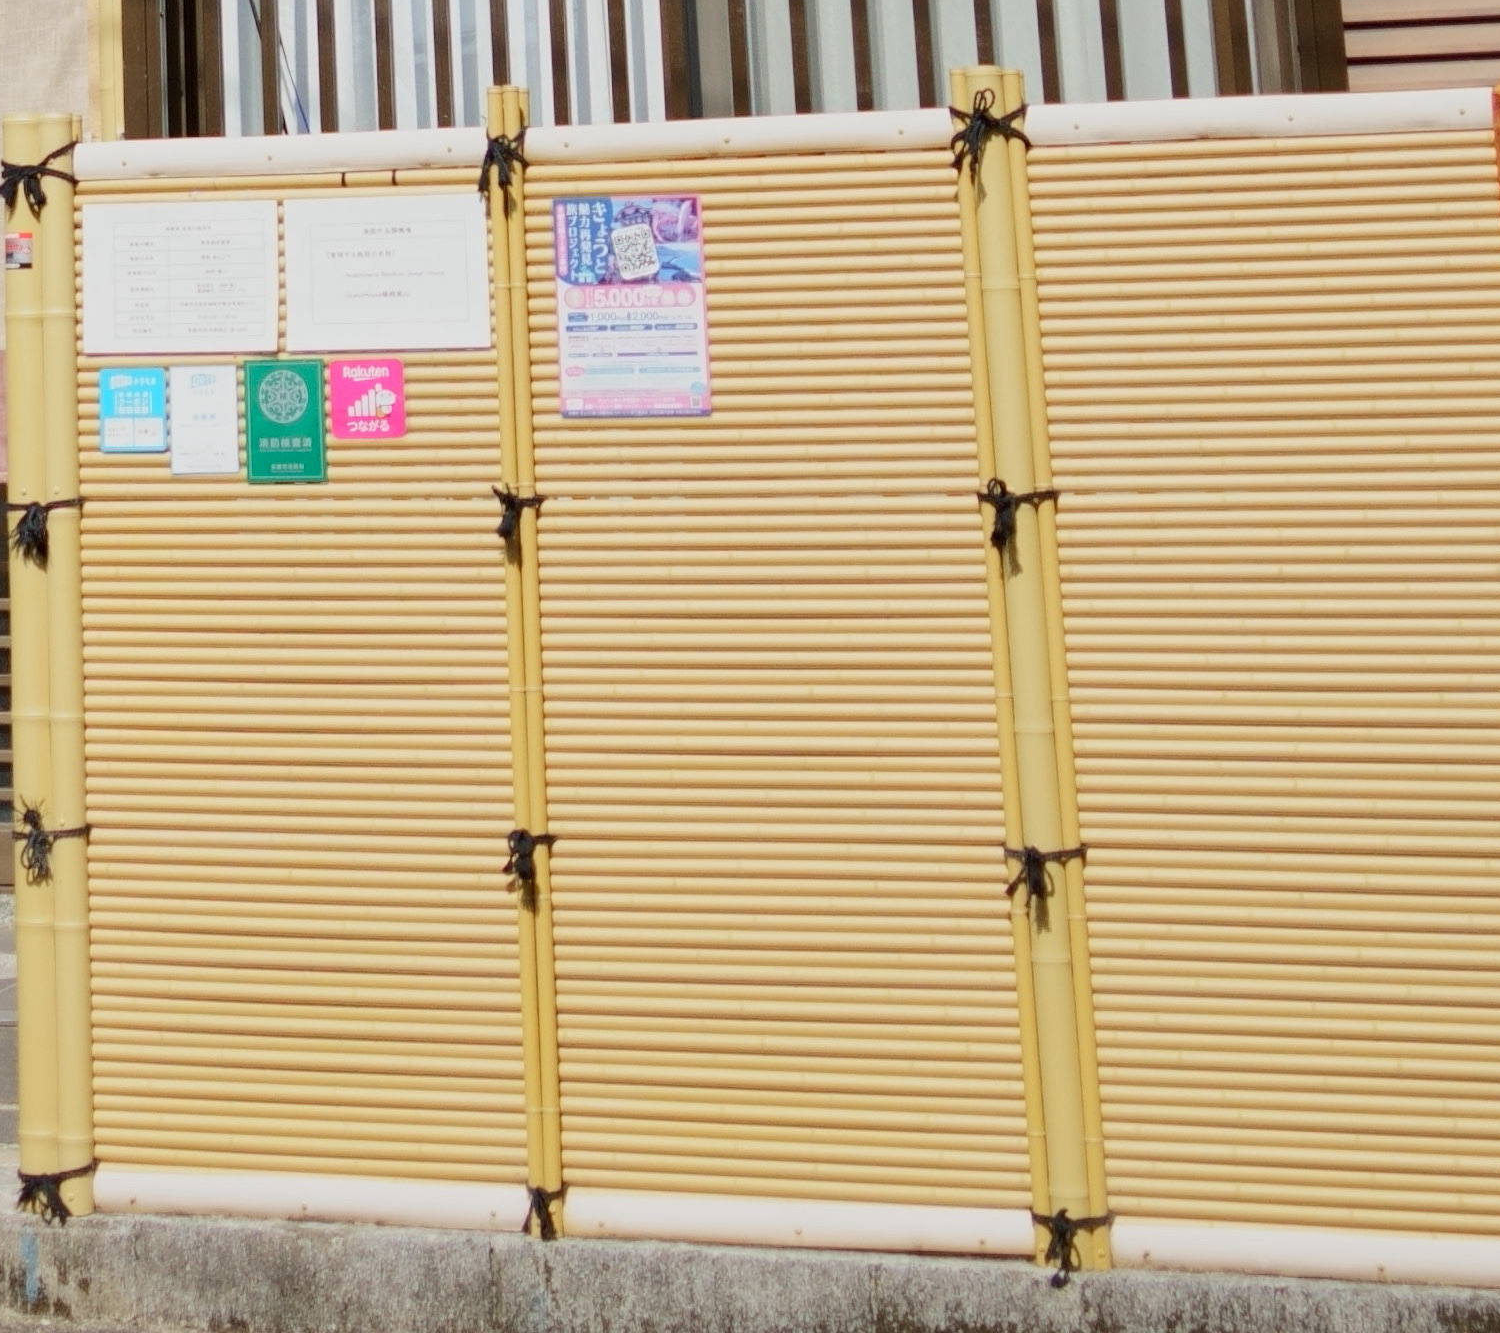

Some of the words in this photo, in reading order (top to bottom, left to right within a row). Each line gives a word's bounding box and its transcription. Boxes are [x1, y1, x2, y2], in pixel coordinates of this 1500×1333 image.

[342, 365, 390, 379] Rakuten
[346, 419, 390, 432] つながる
